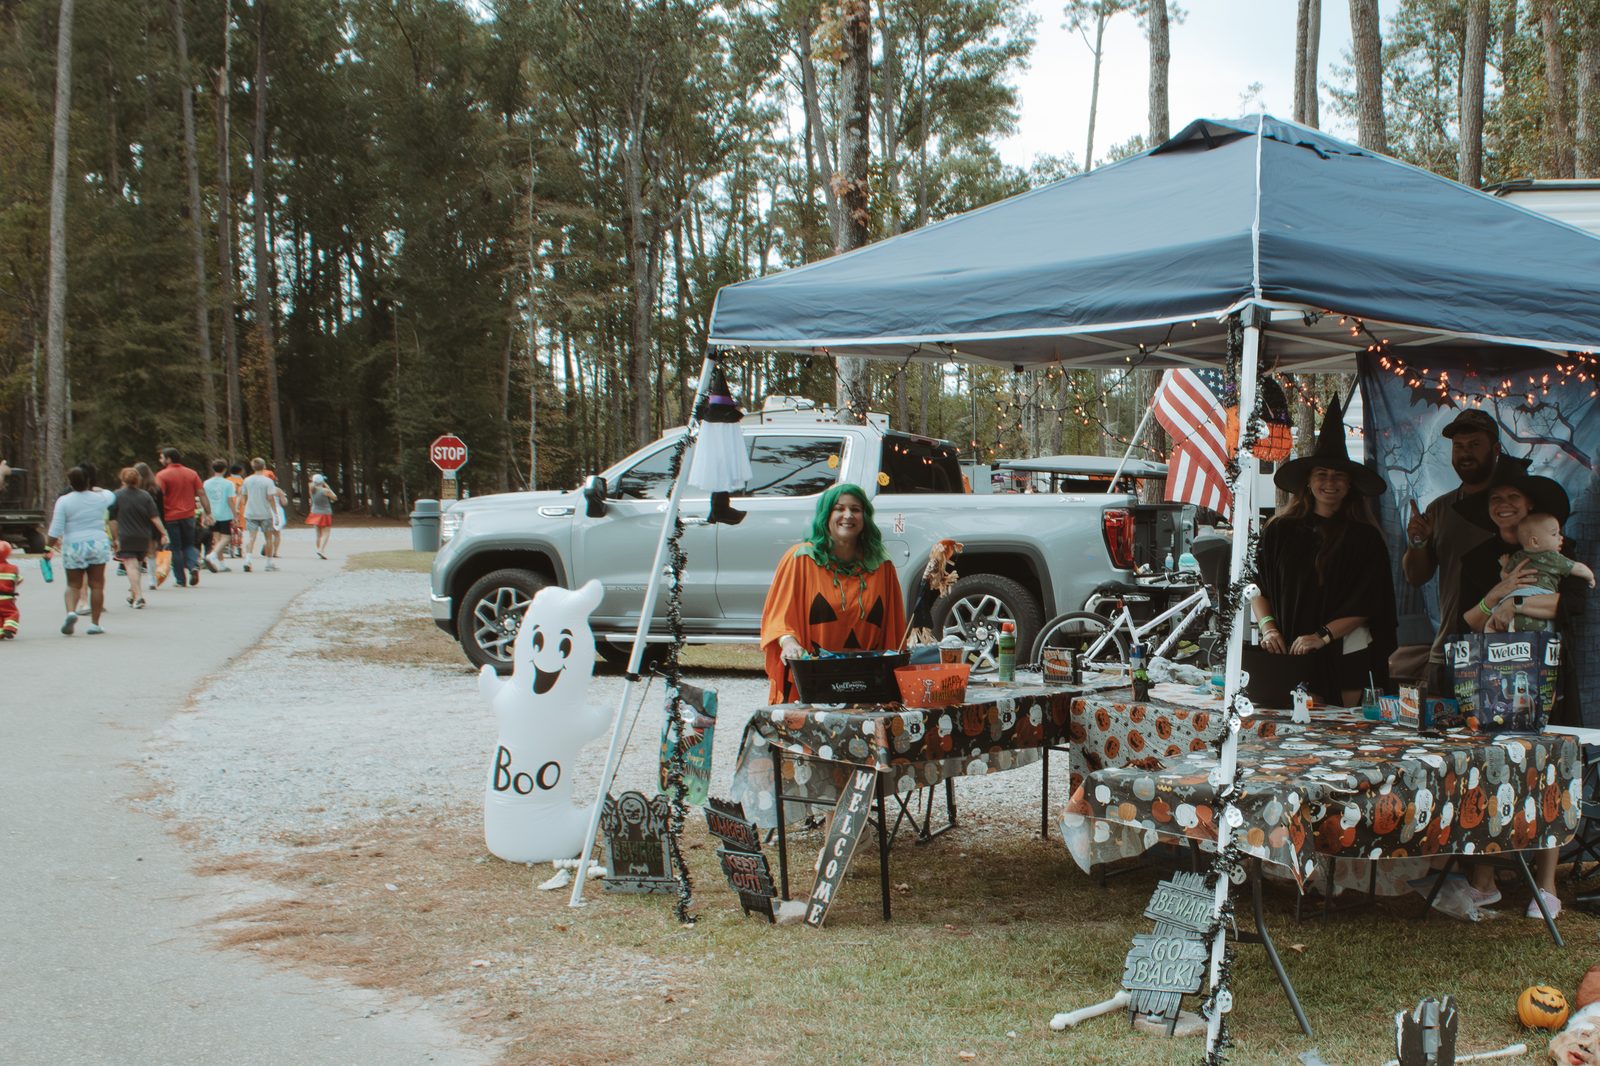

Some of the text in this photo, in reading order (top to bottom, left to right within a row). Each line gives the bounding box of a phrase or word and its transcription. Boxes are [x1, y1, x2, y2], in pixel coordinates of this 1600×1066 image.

[434, 446, 465, 461] STOP
[1490, 644, 1530, 659] Welch's
[807, 770, 873, 924] WELCOME
[725, 854, 758, 874] KEEP
[1154, 891, 1215, 926] BEWARE
[1152, 938, 1184, 961] GO
[1133, 960, 1196, 986] BACK!
